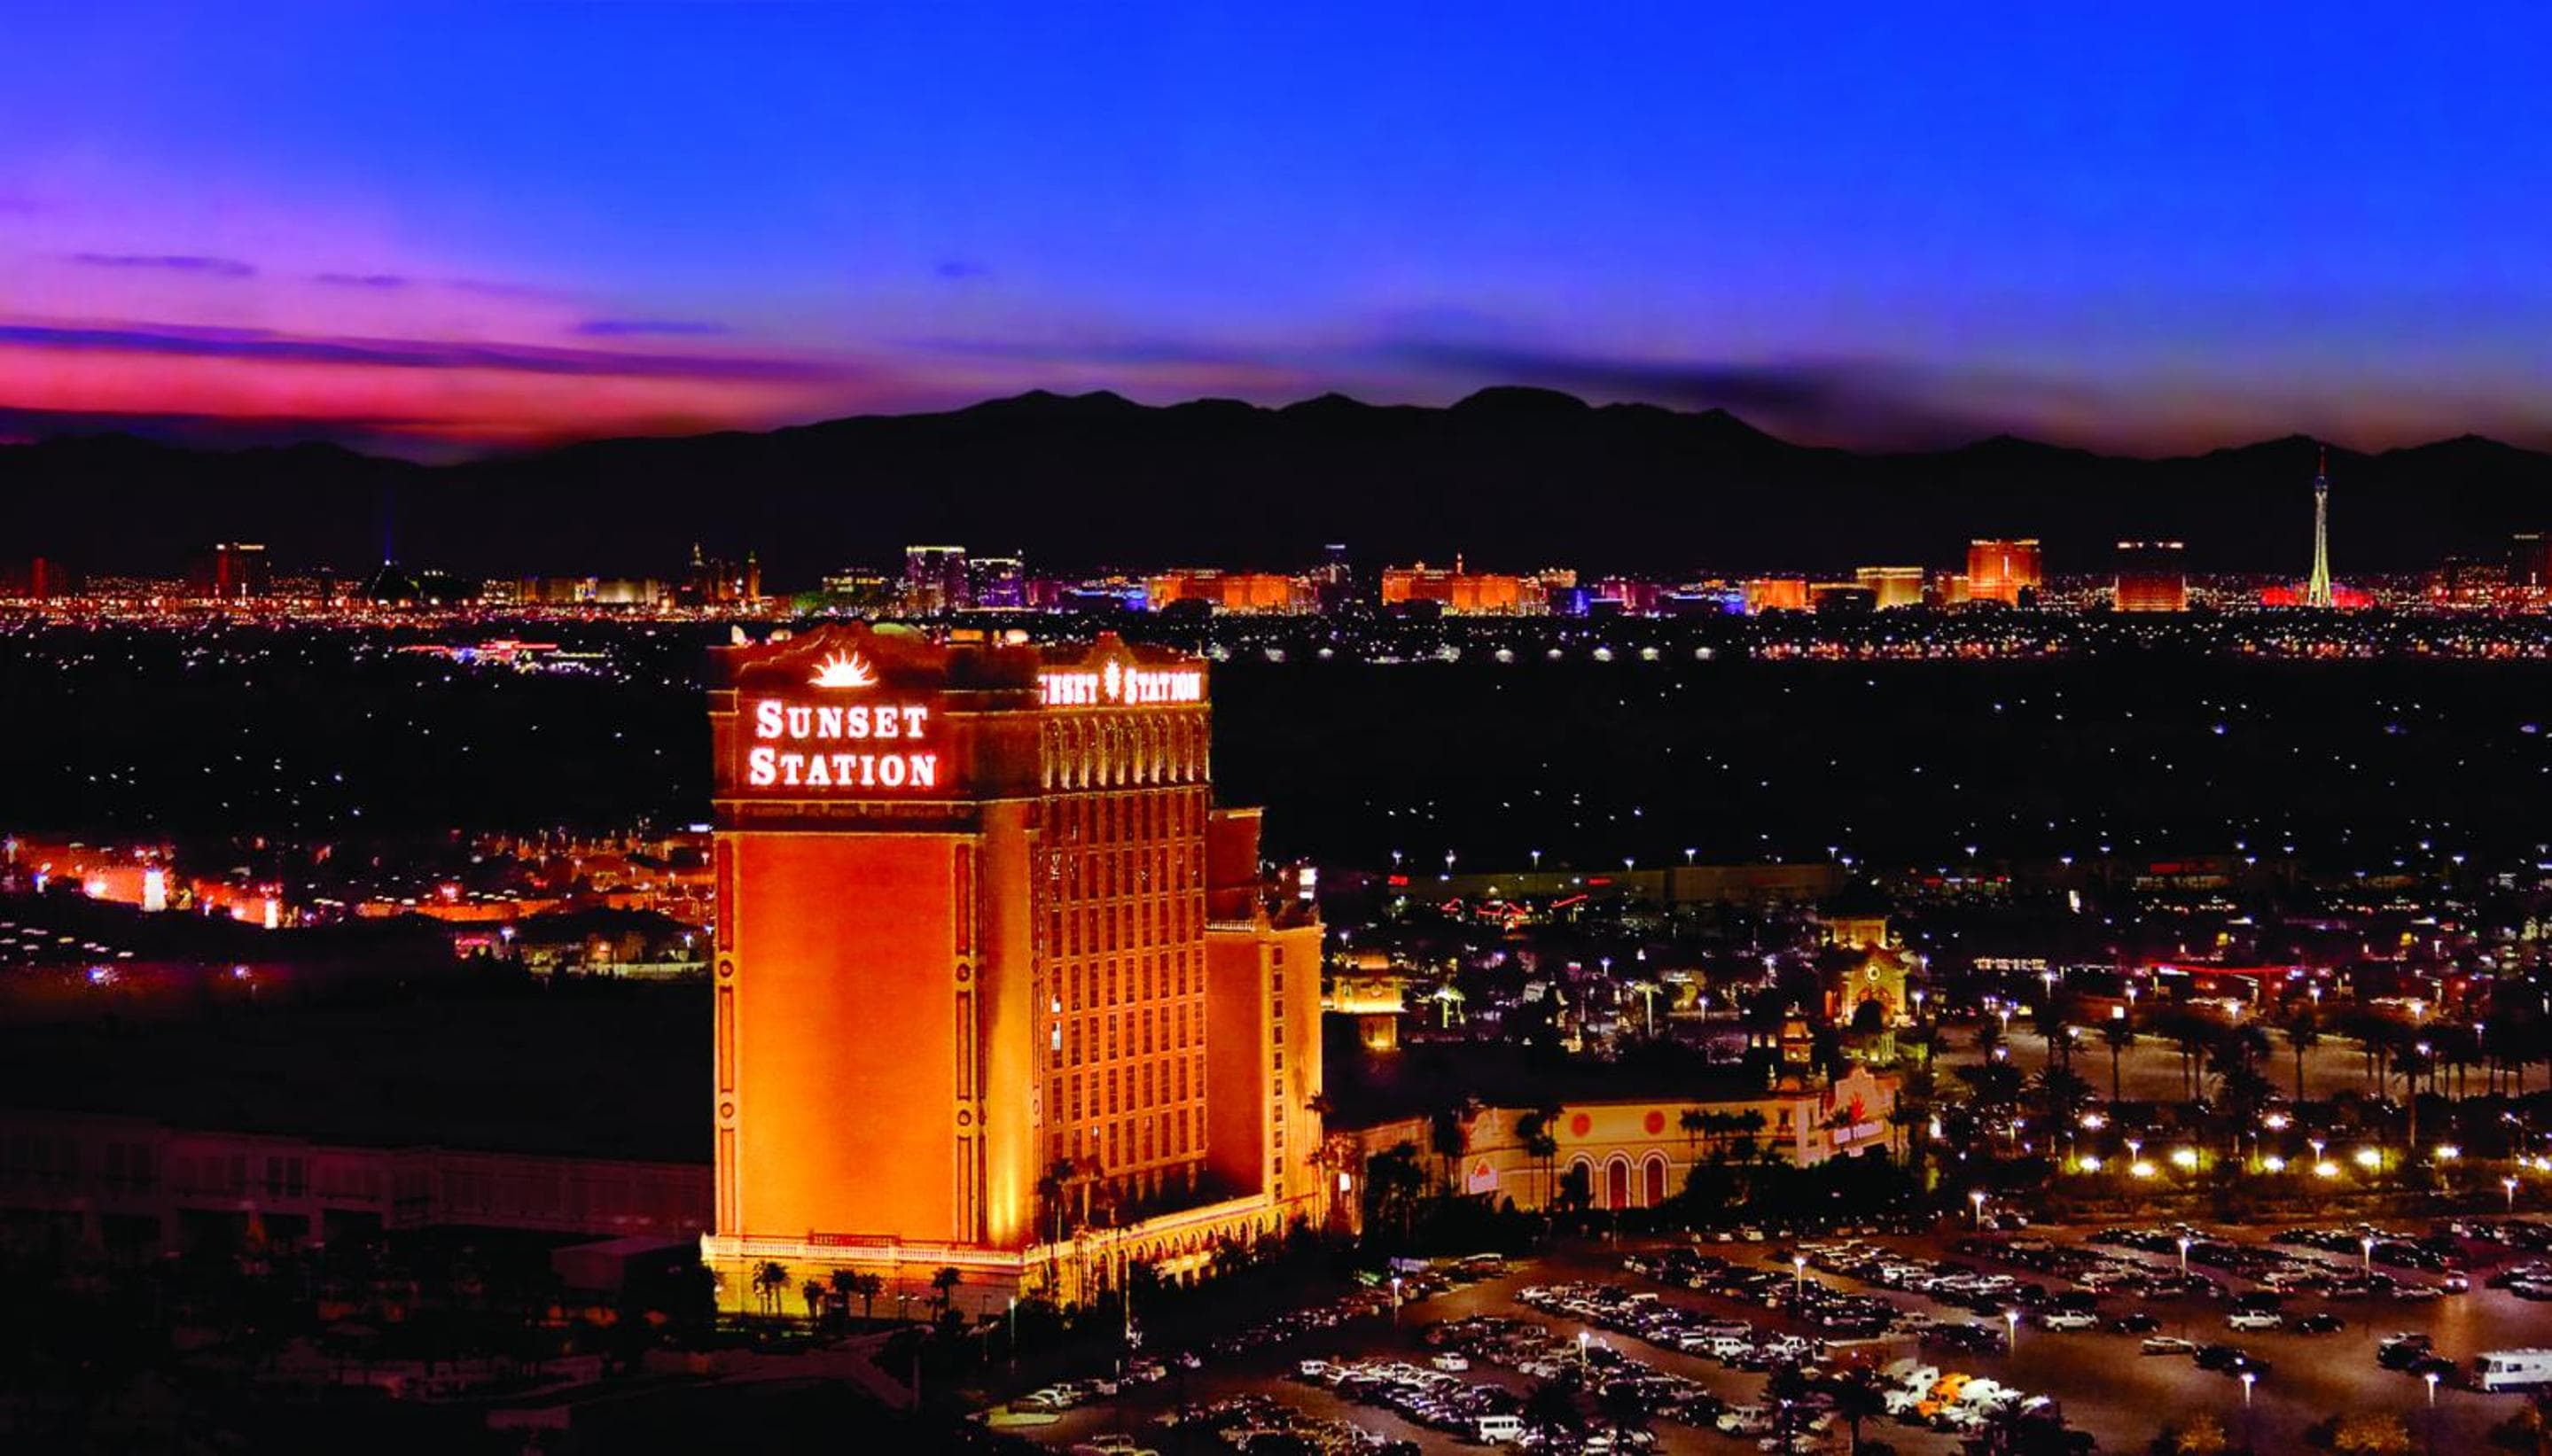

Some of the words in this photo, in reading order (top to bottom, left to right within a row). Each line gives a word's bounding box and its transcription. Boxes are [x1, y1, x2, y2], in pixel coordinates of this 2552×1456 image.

[1124, 667, 1201, 705] STATION
[756, 700, 928, 739] SUNSET
[749, 747, 937, 786] STATION
